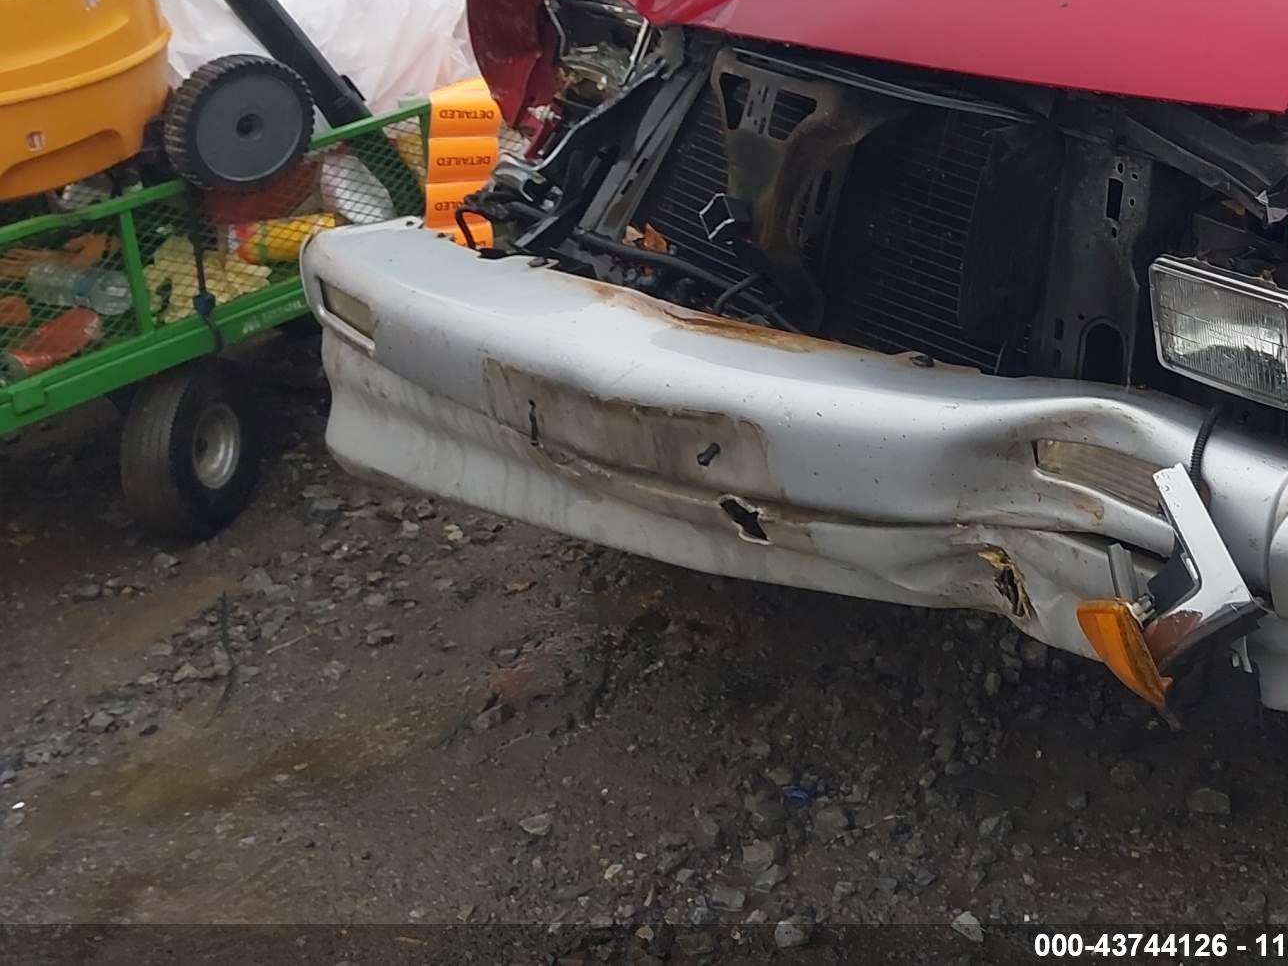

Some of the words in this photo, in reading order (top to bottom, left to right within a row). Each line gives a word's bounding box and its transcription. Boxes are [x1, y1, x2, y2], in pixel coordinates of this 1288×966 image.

[439, 109, 495, 120] DETAILED
[436, 155, 491, 167] DETAILED
[434, 200, 463, 212] ILED
